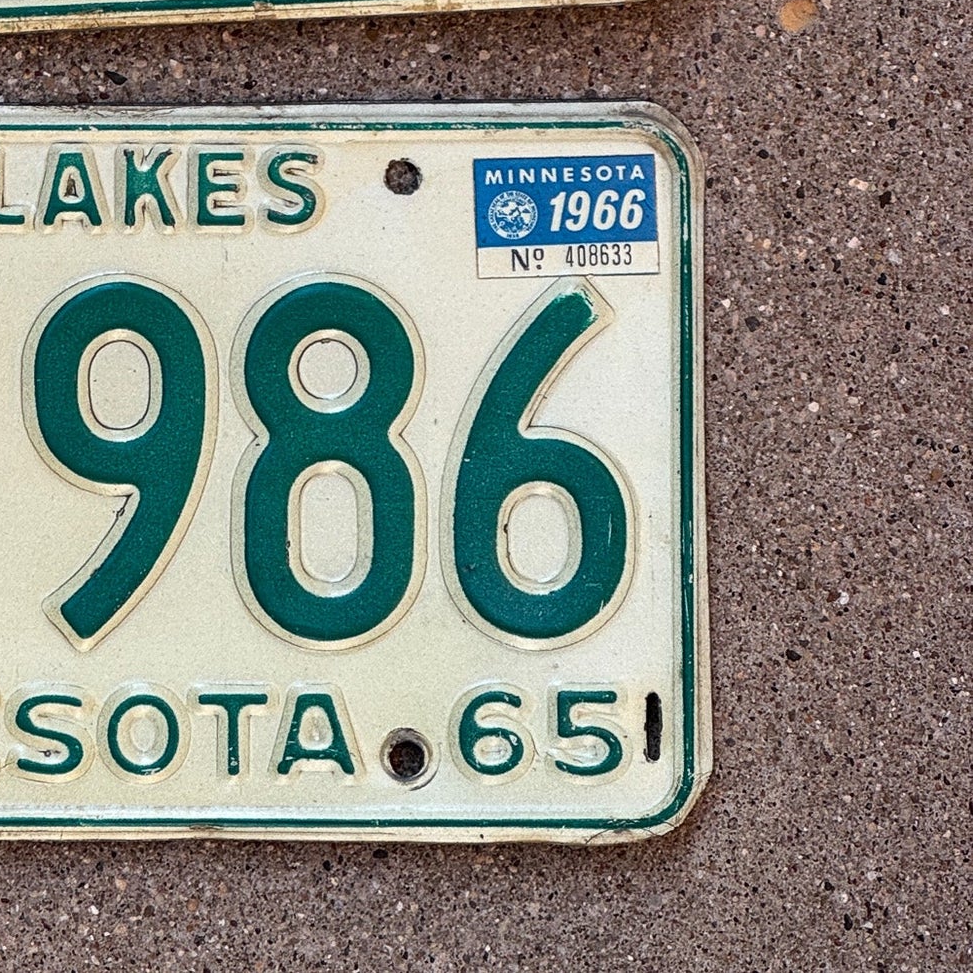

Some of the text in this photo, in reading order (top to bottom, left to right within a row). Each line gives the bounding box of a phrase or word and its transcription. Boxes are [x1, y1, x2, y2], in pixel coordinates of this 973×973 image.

[484, 164, 646, 185] MINNESOTA
[549, 188, 647, 233] 1966
[565, 243, 633, 268] 408633
[32, 280, 629, 643] 986
[457, 690, 624, 777] 65
